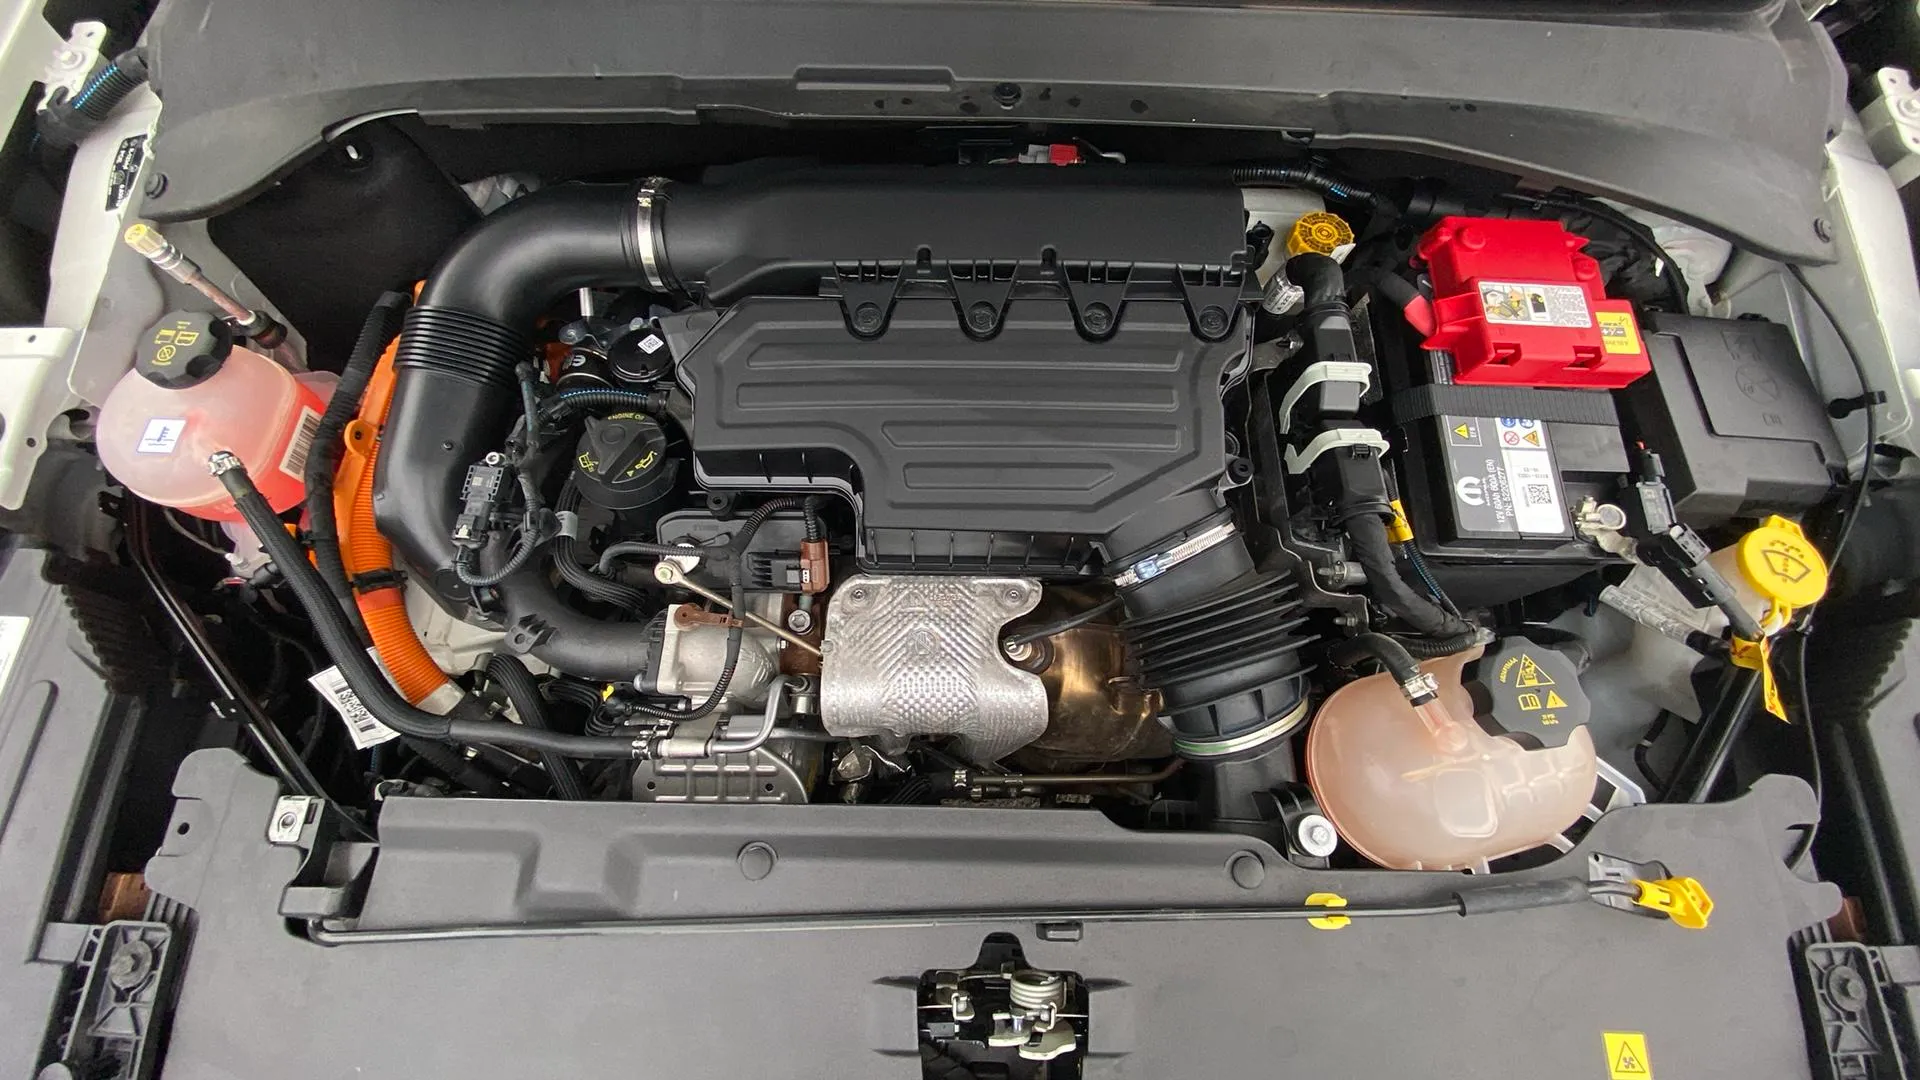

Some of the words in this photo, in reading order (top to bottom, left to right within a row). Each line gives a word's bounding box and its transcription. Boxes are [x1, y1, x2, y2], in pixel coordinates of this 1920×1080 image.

[607, 412, 634, 421] ENGINE
[1488, 473, 1499, 492] 600A
[1491, 492, 1502, 510] 60Ah
[1494, 510, 1505, 523] 12V
[1504, 503, 1515, 517] PN:
